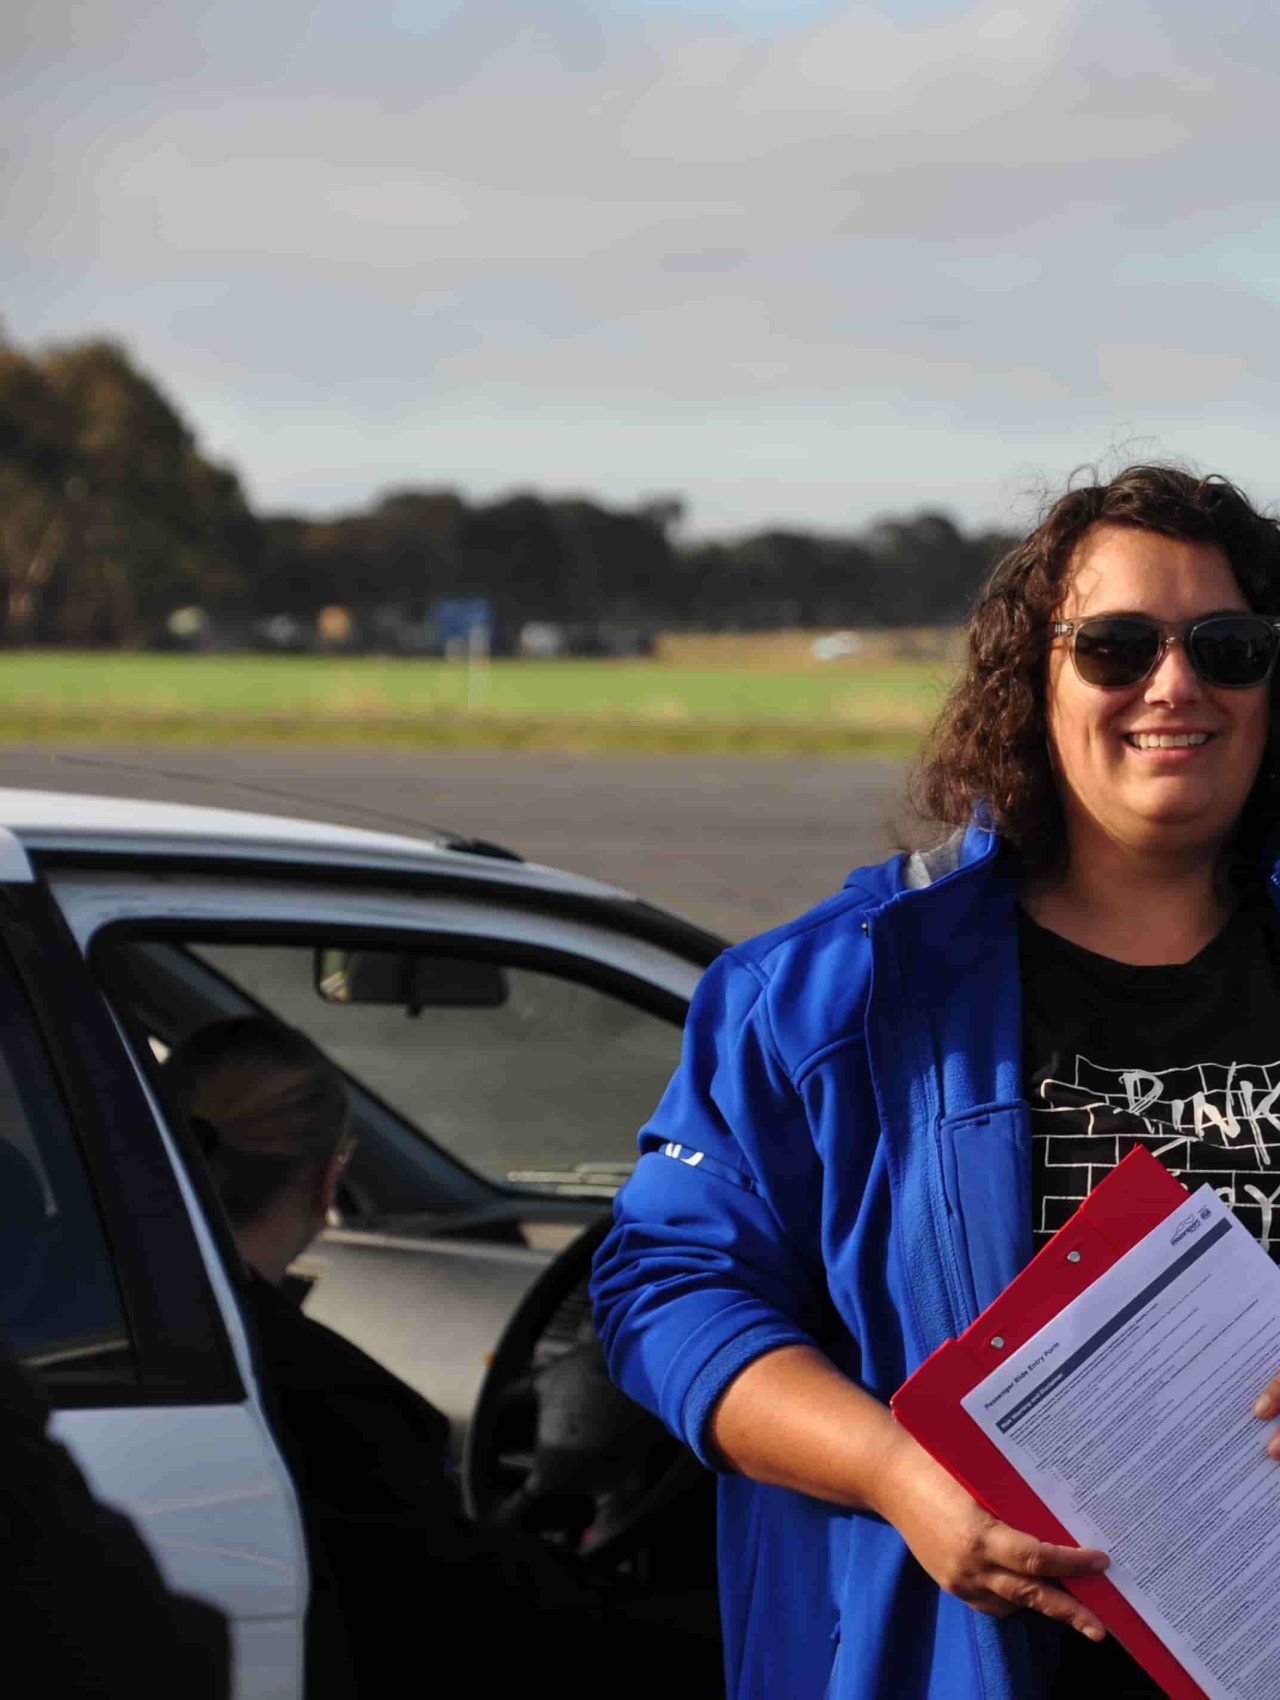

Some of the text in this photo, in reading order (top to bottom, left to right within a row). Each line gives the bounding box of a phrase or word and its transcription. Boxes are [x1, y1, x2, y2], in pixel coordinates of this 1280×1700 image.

[984, 1342, 1059, 1409] Passenger Ride Entry Form
[1001, 1419, 1012, 1429] Risk
[1031, 1393, 1041, 1402] and
